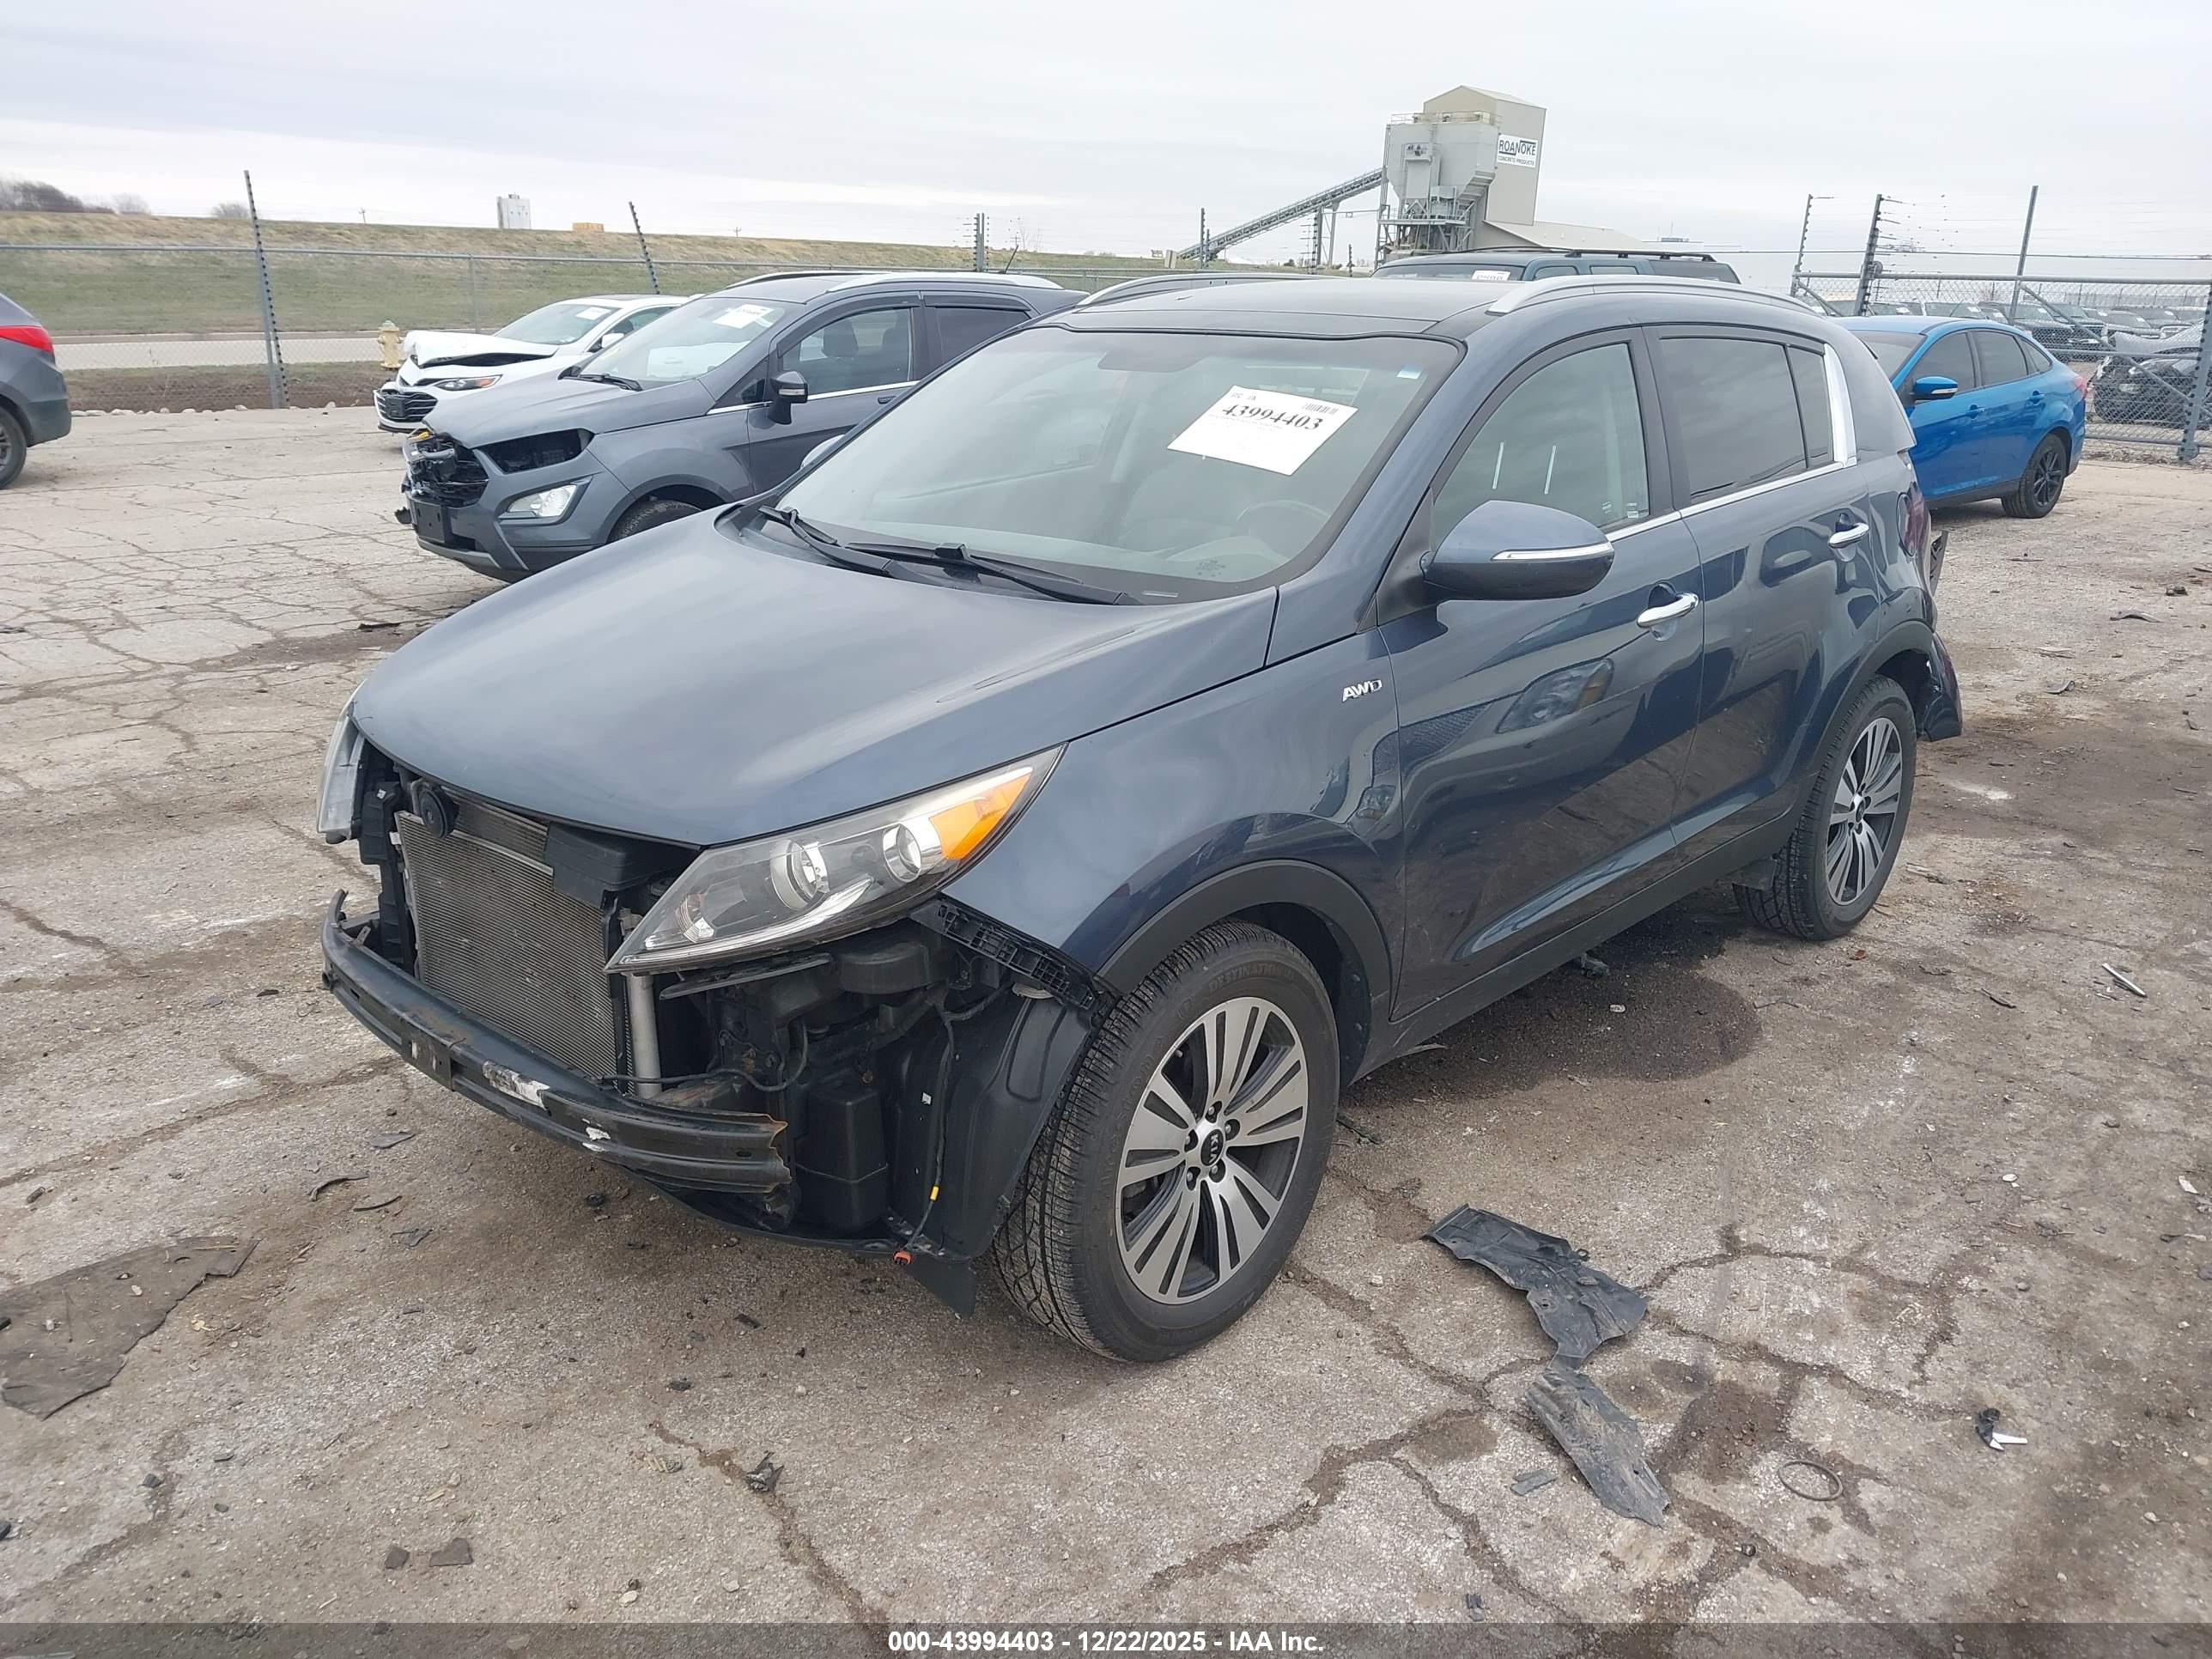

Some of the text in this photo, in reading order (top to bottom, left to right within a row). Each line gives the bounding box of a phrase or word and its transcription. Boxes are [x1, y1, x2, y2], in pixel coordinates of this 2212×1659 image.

[1498, 140, 1537, 155] ROANOKE
[1222, 404, 1323, 430] 43994403
[1342, 679, 1382, 702] AWD
[1208, 1133, 1218, 1164] KIA
